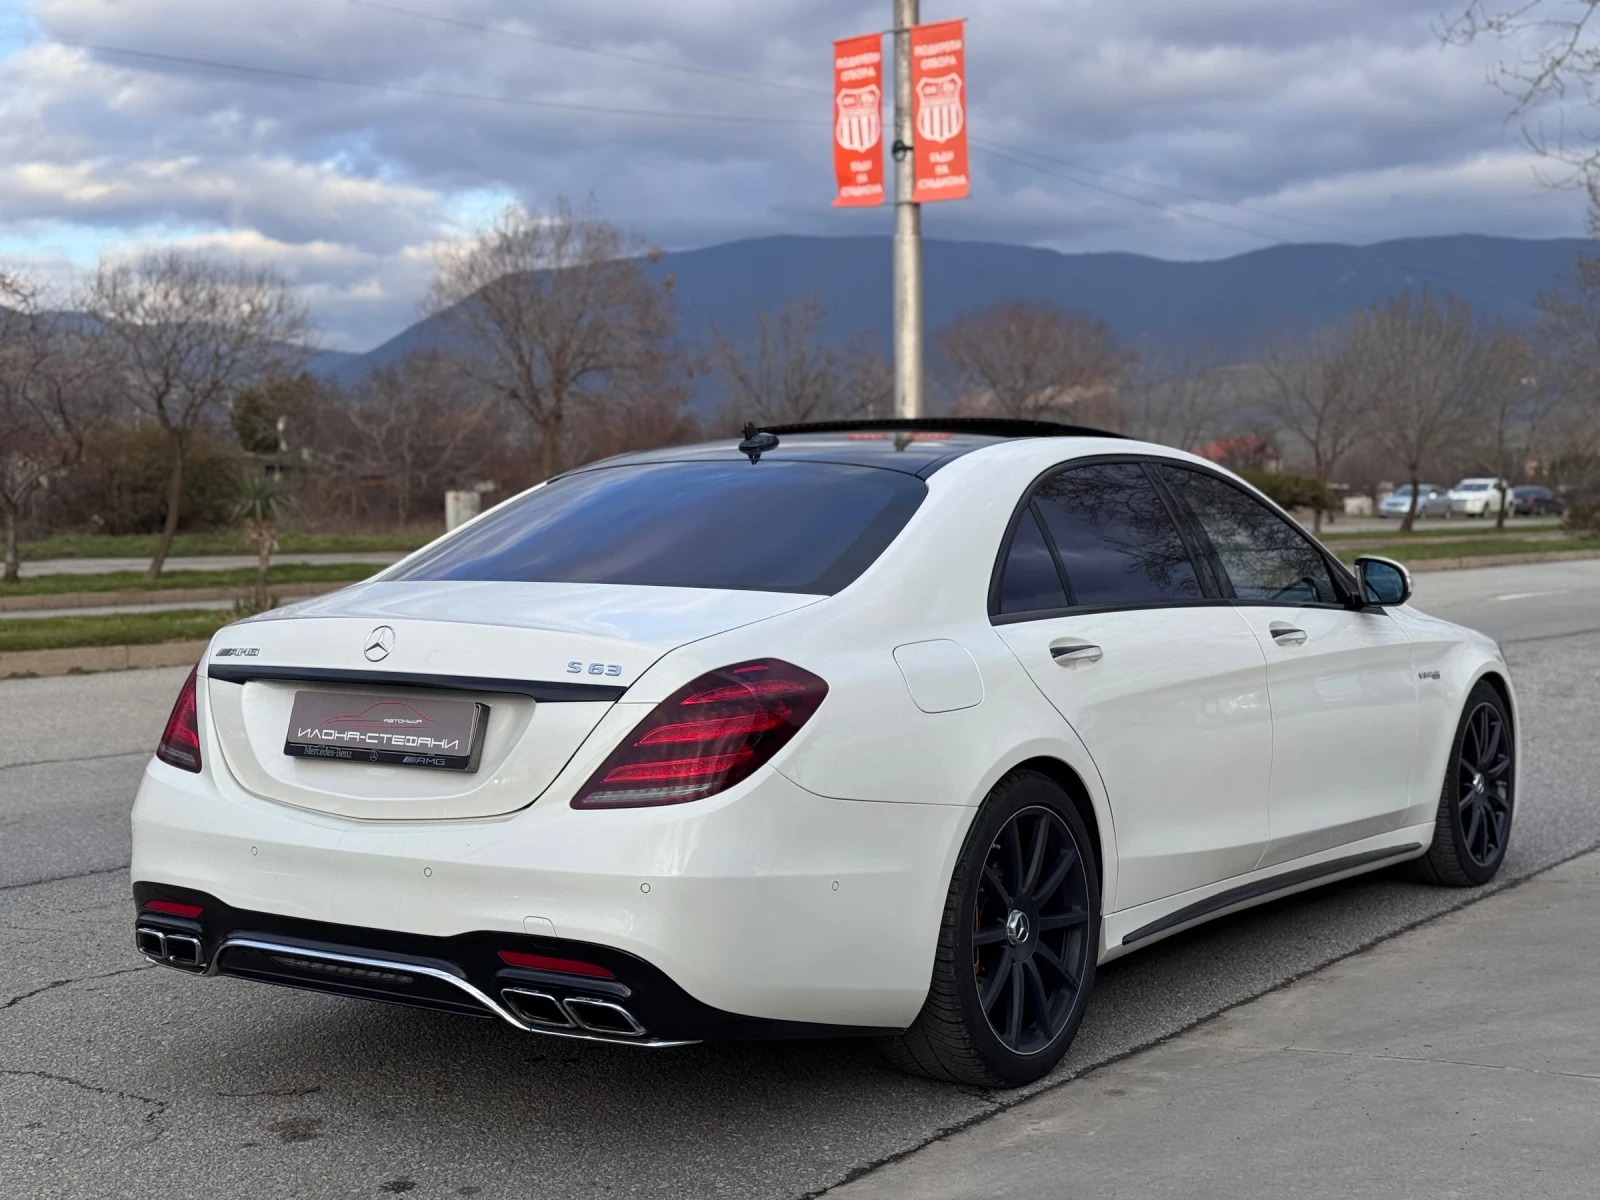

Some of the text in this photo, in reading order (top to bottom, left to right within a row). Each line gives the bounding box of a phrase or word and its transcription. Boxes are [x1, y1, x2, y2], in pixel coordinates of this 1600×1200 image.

[228, 648, 260, 656] AMG
[566, 661, 622, 676] S 63
[298, 728, 459, 750] ИЛОНА-СТЕФАНИ
[303, 746, 353, 759] Mercedes-Benz
[416, 756, 446, 766] AMG
